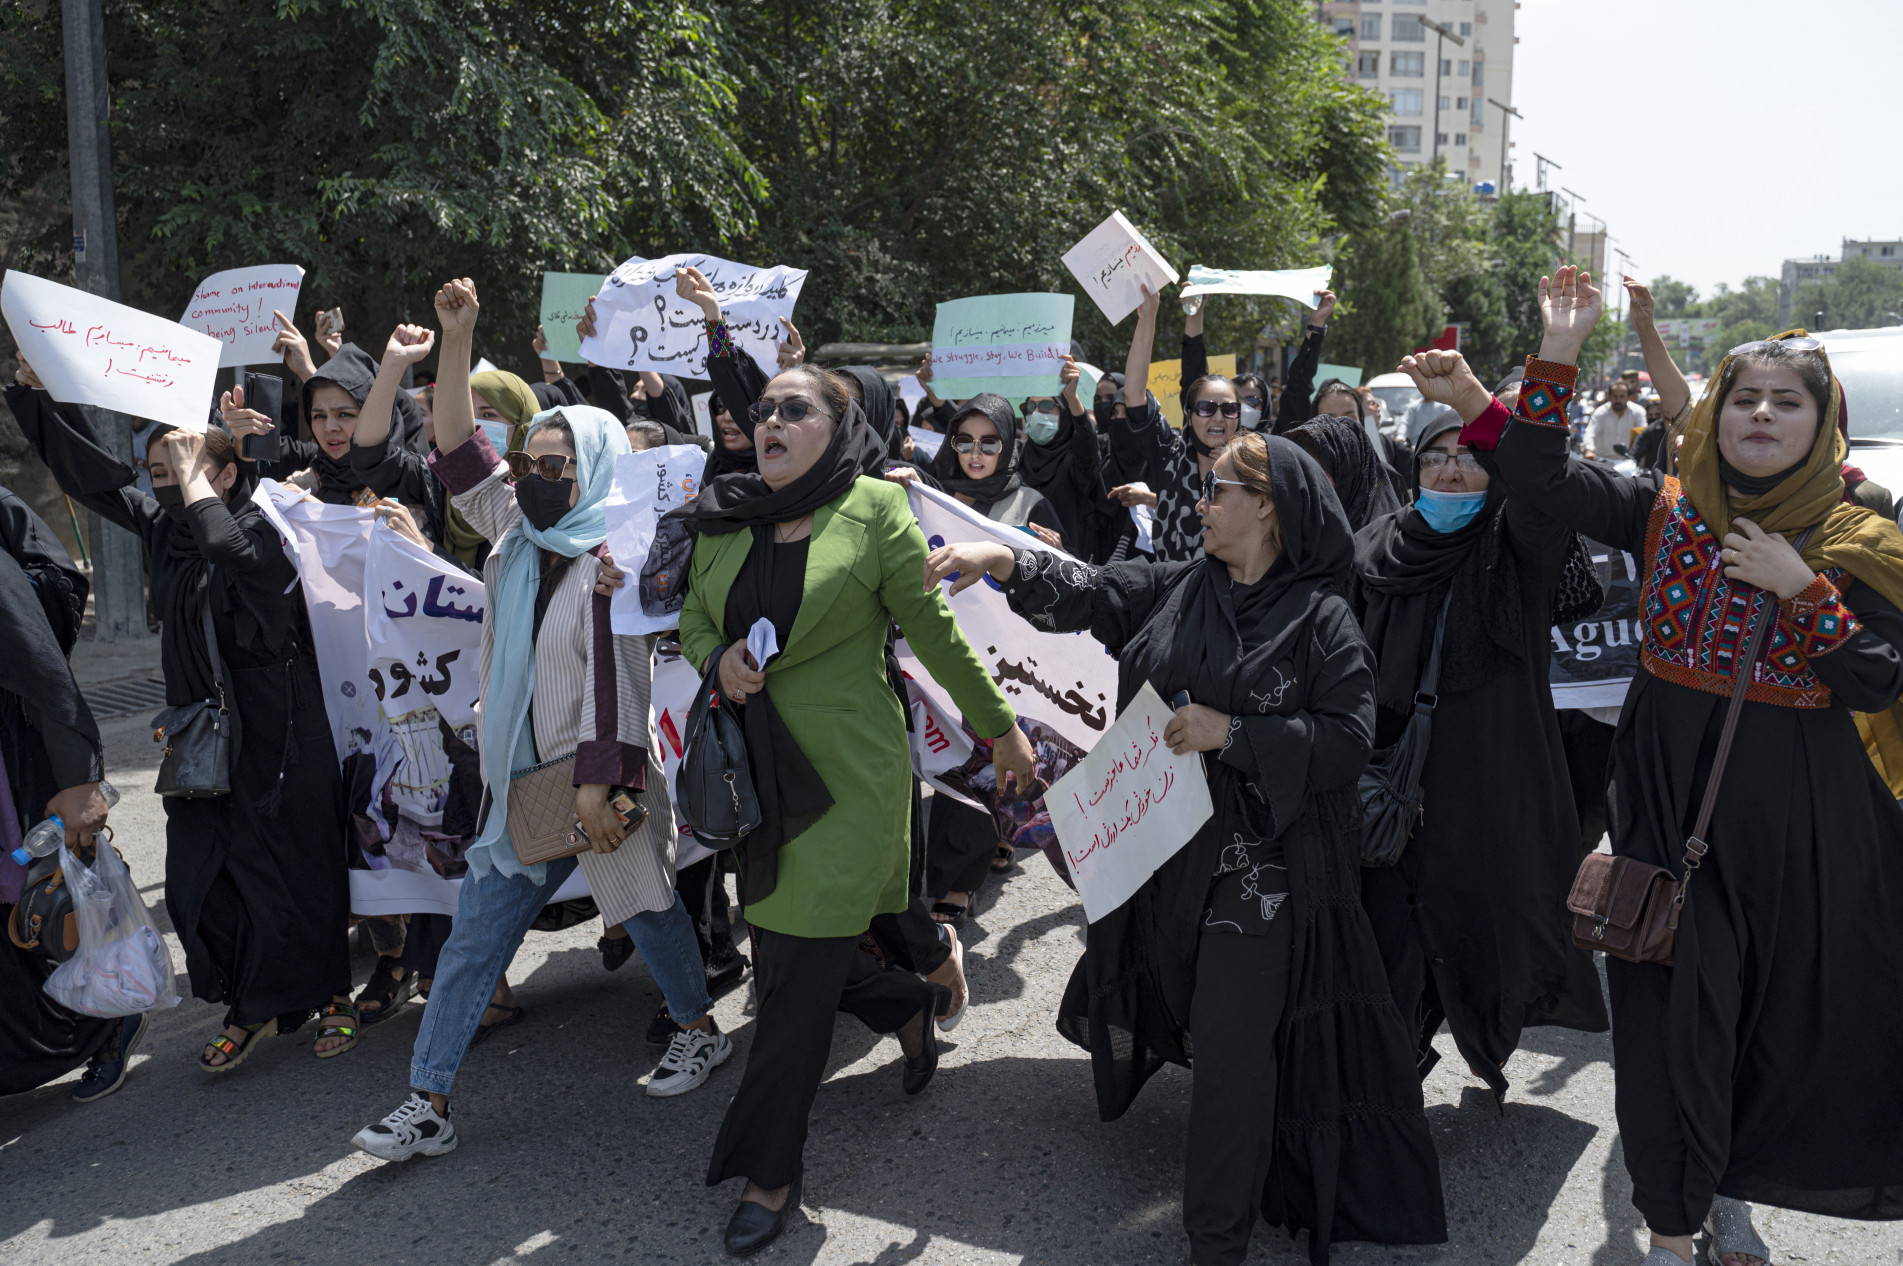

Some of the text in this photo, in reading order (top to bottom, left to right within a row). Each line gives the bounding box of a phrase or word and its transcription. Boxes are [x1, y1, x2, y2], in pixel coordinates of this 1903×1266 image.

[231, 286, 243, 295] on
[191, 302, 249, 323] community
[29, 319, 77, 334] طالب
[207, 316, 278, 344] being silent
[1124, 741, 1143, 770] شما
